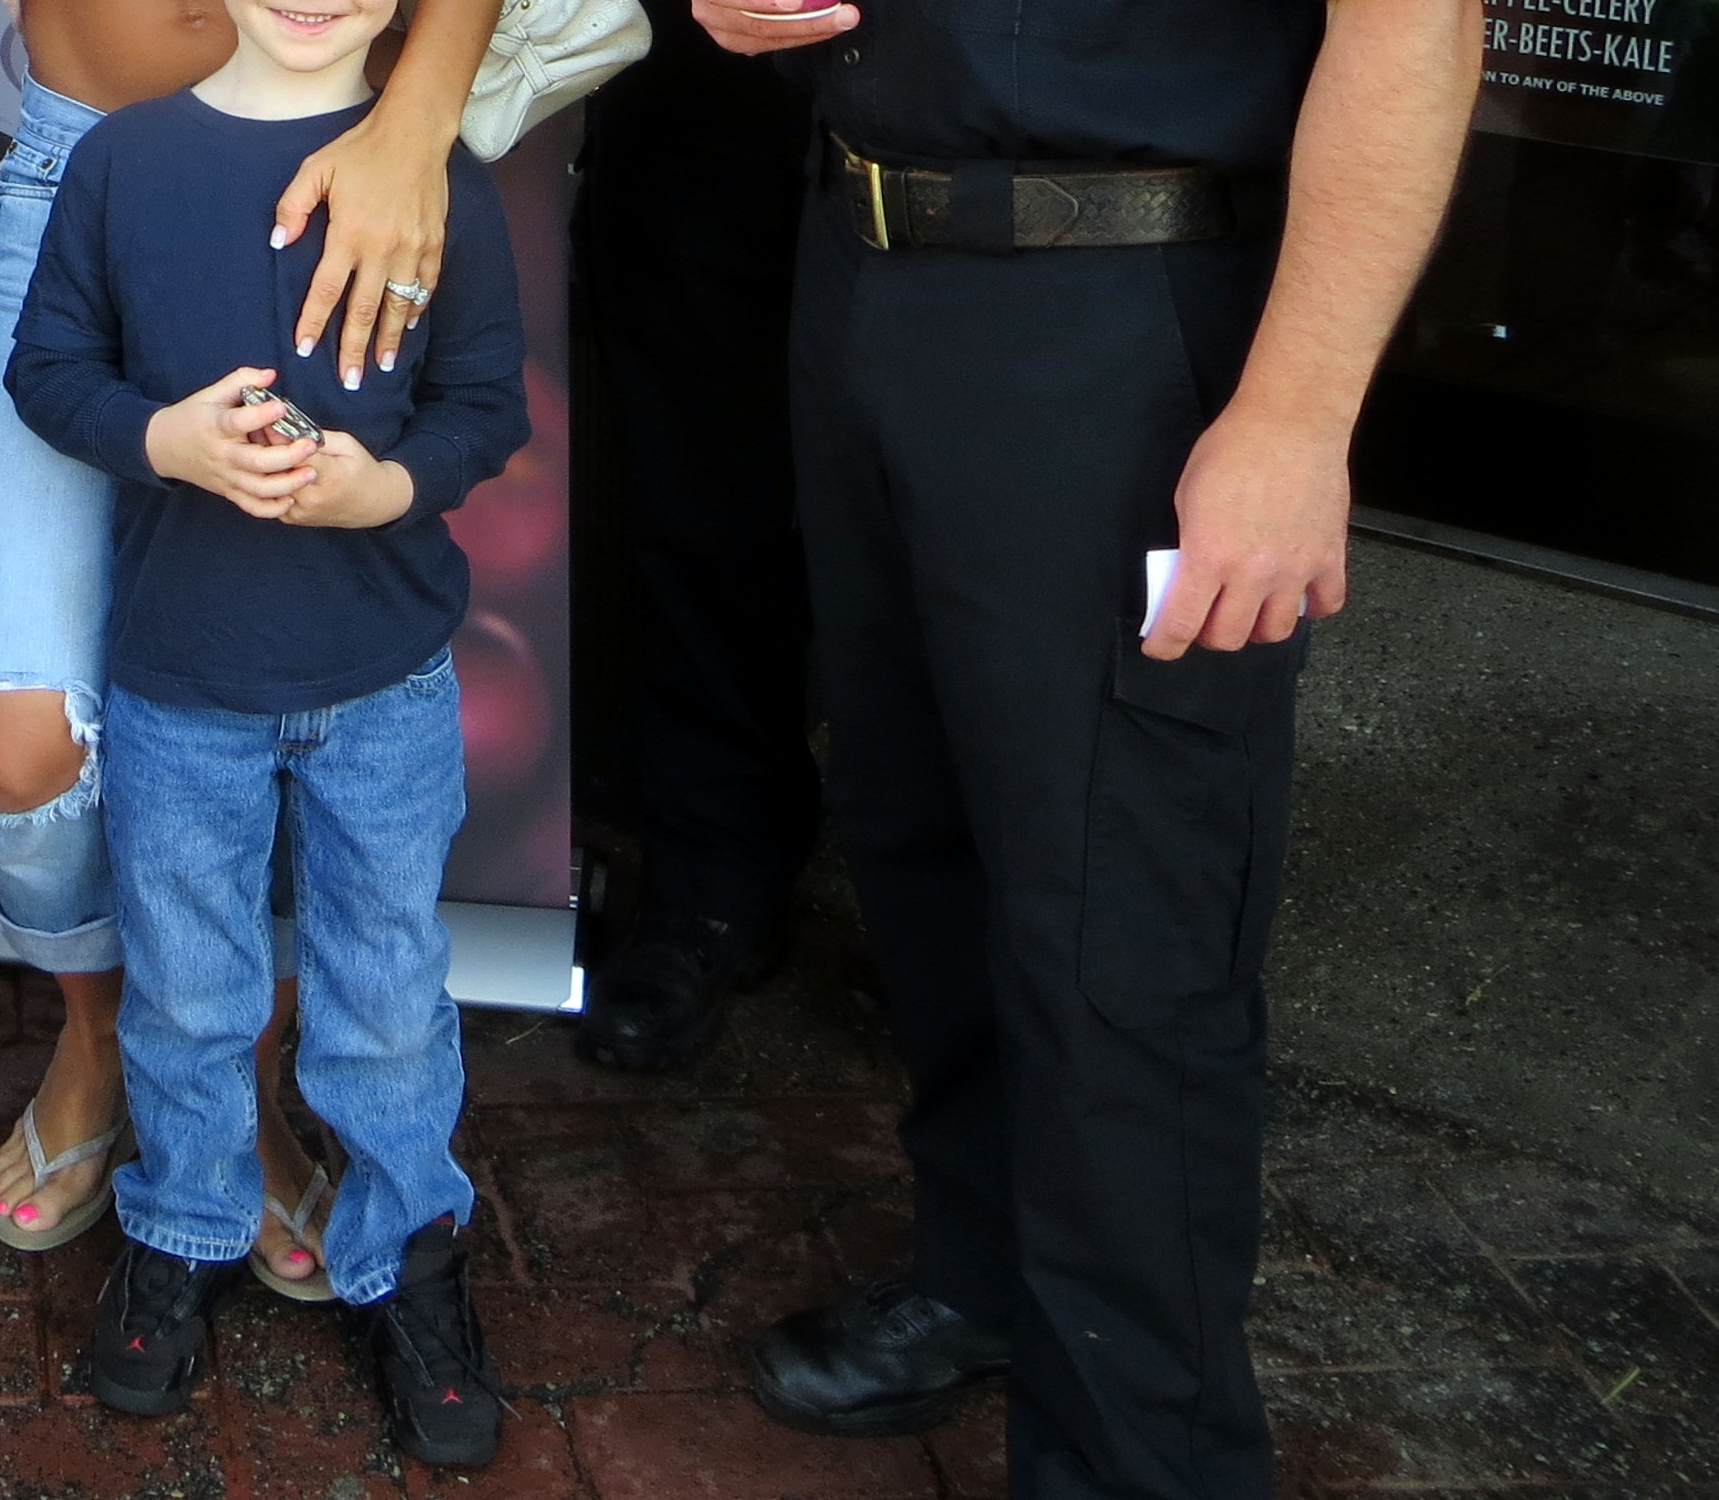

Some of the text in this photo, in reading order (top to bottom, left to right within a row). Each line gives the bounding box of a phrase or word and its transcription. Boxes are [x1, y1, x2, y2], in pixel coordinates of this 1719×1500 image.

[1500, 72, 1520, 86] TO
[1522, 75, 1554, 91] ANY
[1556, 80, 1577, 93] OF
[1580, 83, 1609, 99] THE
[1612, 88, 1664, 106] ABOVE
